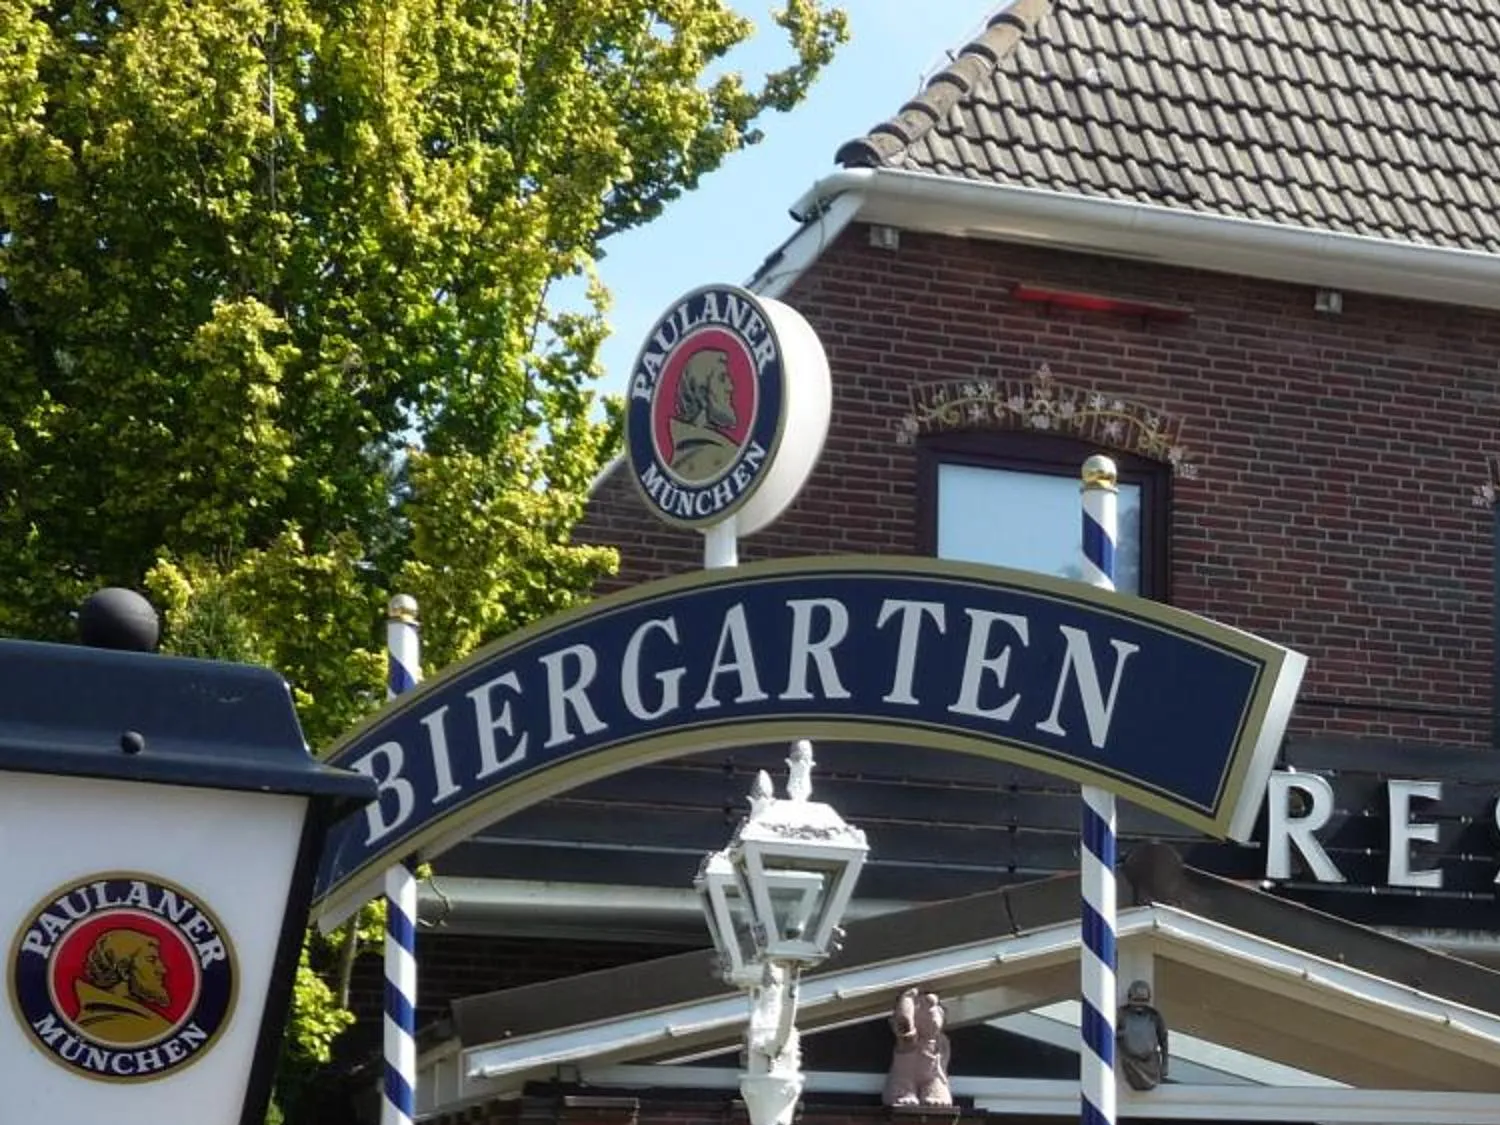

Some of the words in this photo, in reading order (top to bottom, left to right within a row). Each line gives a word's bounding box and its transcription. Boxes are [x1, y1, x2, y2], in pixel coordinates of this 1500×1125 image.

[633, 292, 775, 401] PAULANER
[641, 439, 767, 517] MÜNCHEN
[353, 598, 1141, 847] BIERGARTEN
[22, 880, 227, 970] PAULANER
[33, 1012, 209, 1075] MÜNCHEN
